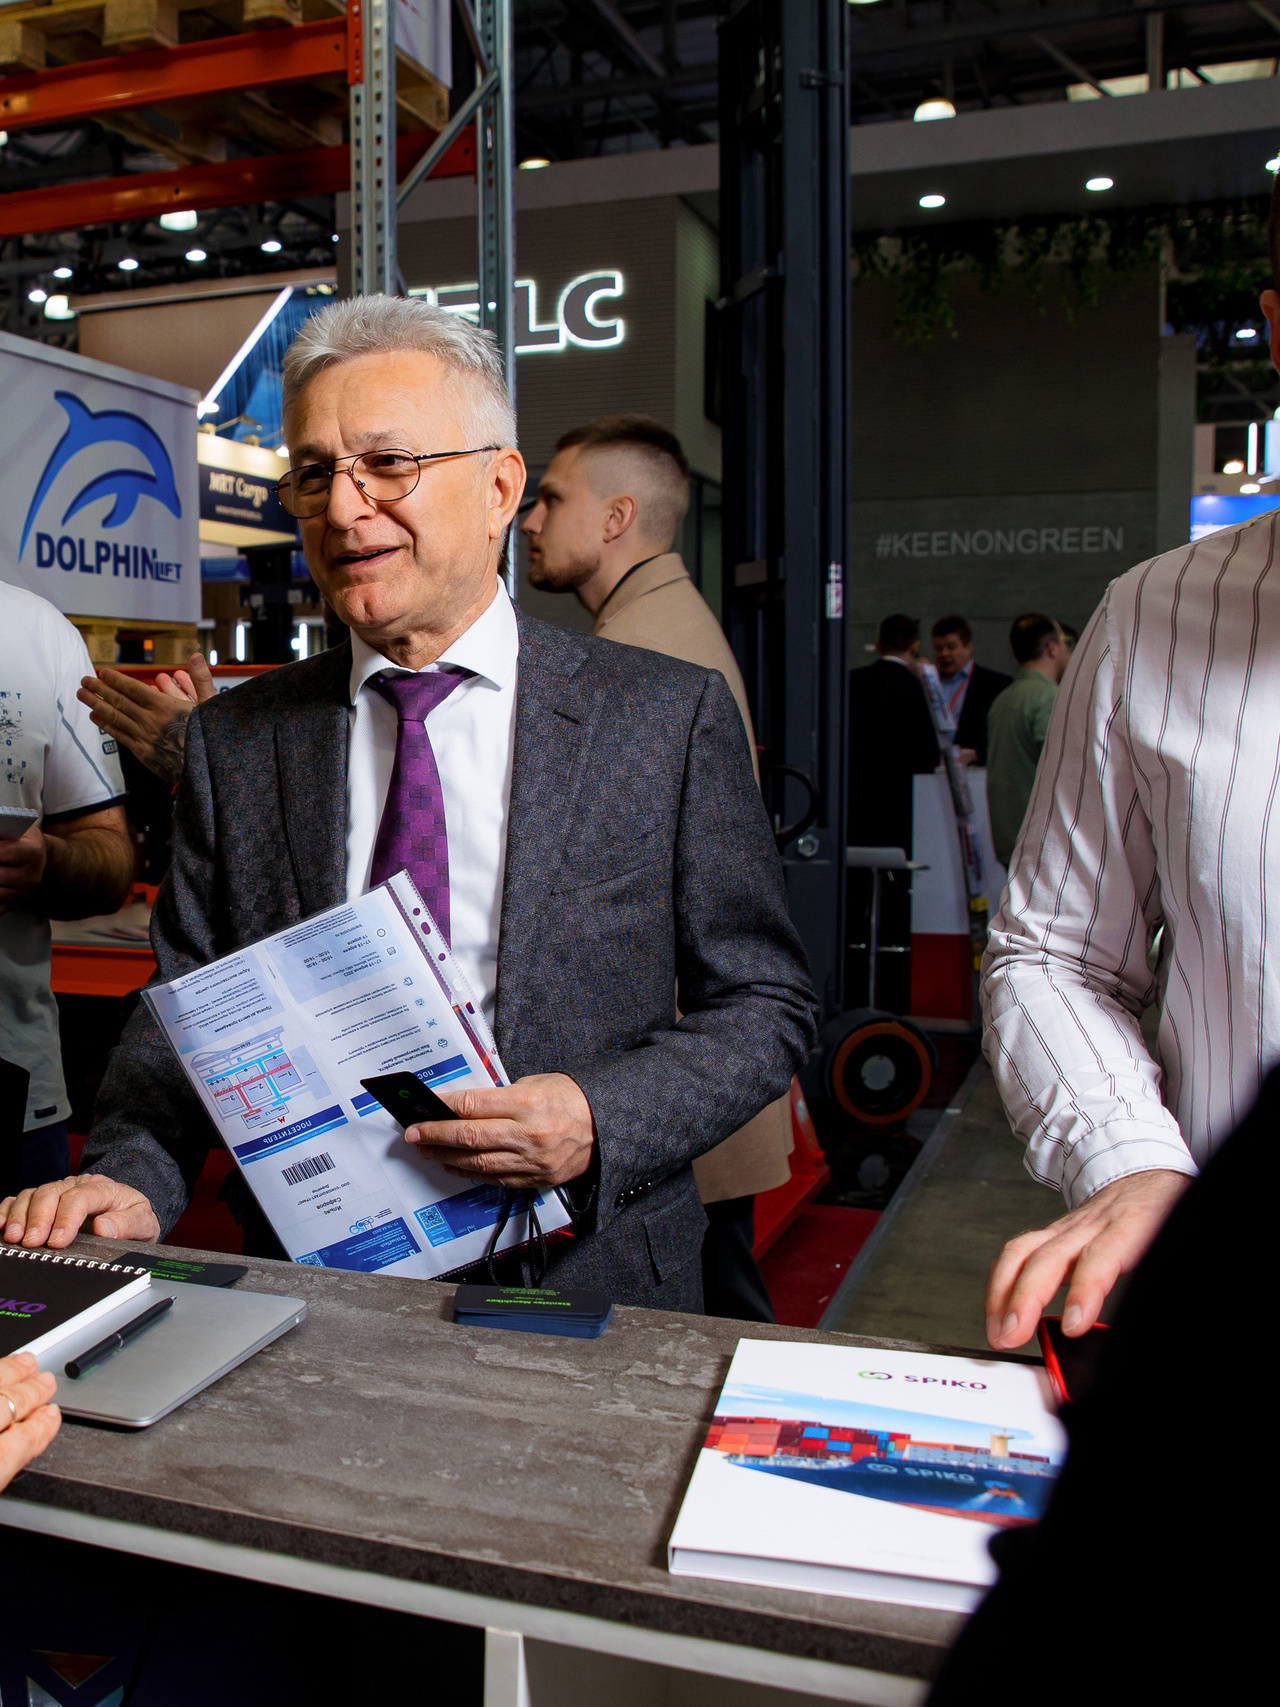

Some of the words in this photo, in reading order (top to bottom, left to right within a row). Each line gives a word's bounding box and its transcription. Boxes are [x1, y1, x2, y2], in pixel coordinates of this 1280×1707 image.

[876, 526, 1124, 557] #KEENONGREEN
[36, 532, 155, 581] DOLPHIN
[416, 1068, 434, 1080] ПОС
[261, 1119, 312, 1144] ПОСЕТИТЕЛЬ
[315, 1196, 342, 1210] Сафаров
[904, 1374, 987, 1390] SPIKO
[904, 1466, 975, 1483] SPIKO
